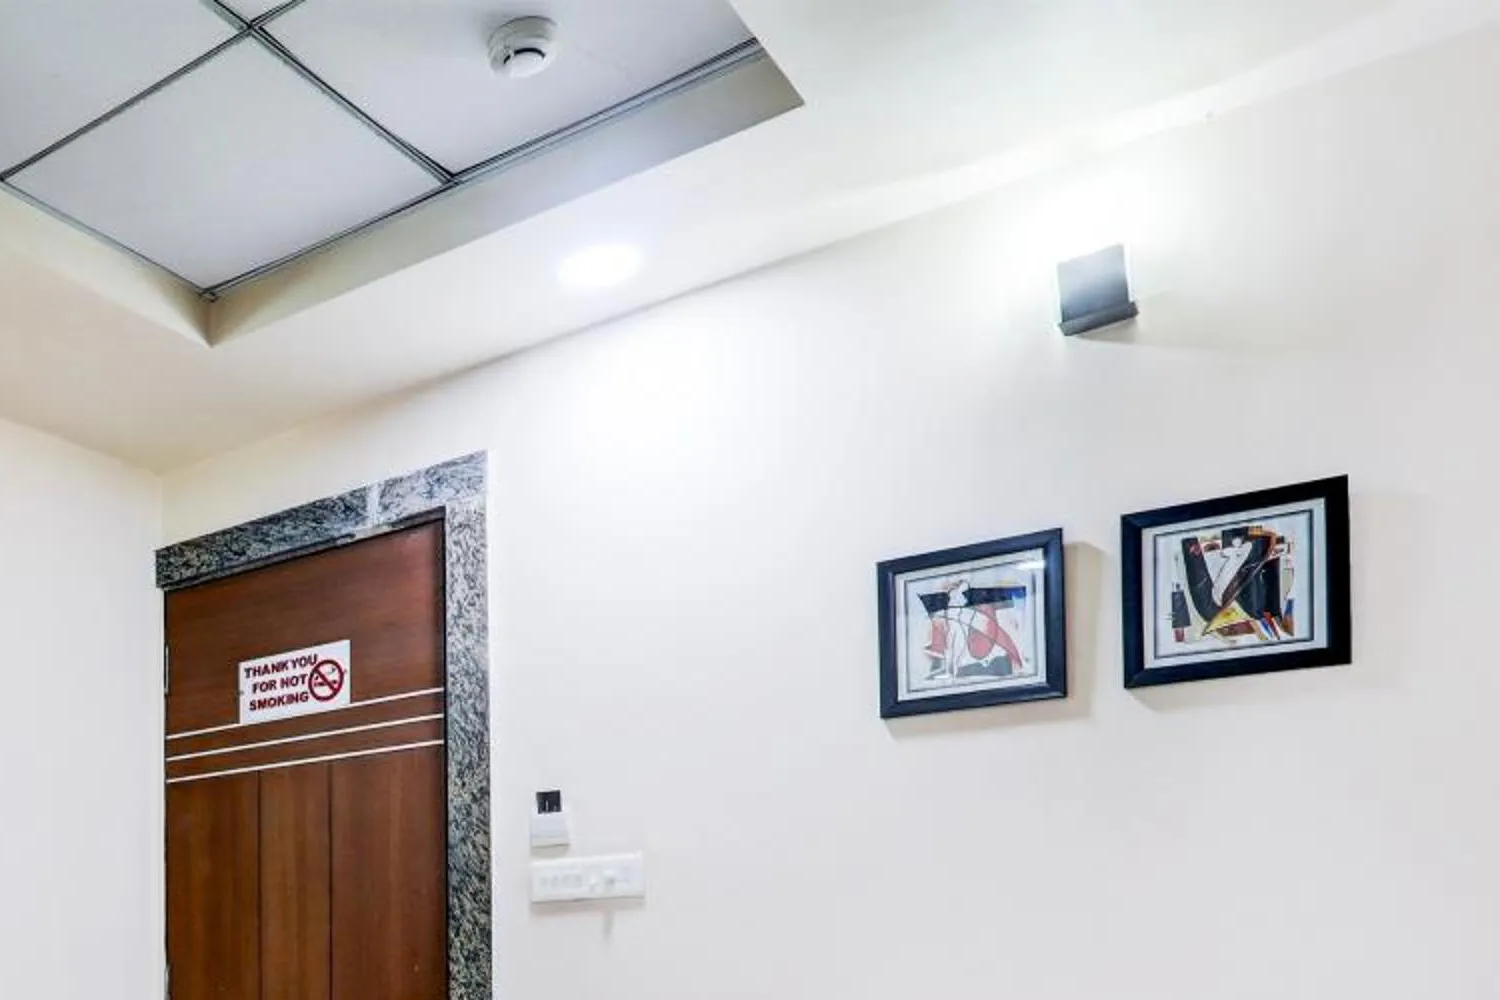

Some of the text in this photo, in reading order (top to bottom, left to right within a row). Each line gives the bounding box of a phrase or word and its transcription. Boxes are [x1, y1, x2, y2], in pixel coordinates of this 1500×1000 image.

[290, 653, 318, 669] YOU
[252, 679, 277, 694] FOR
[249, 691, 309, 711] SMOKING
